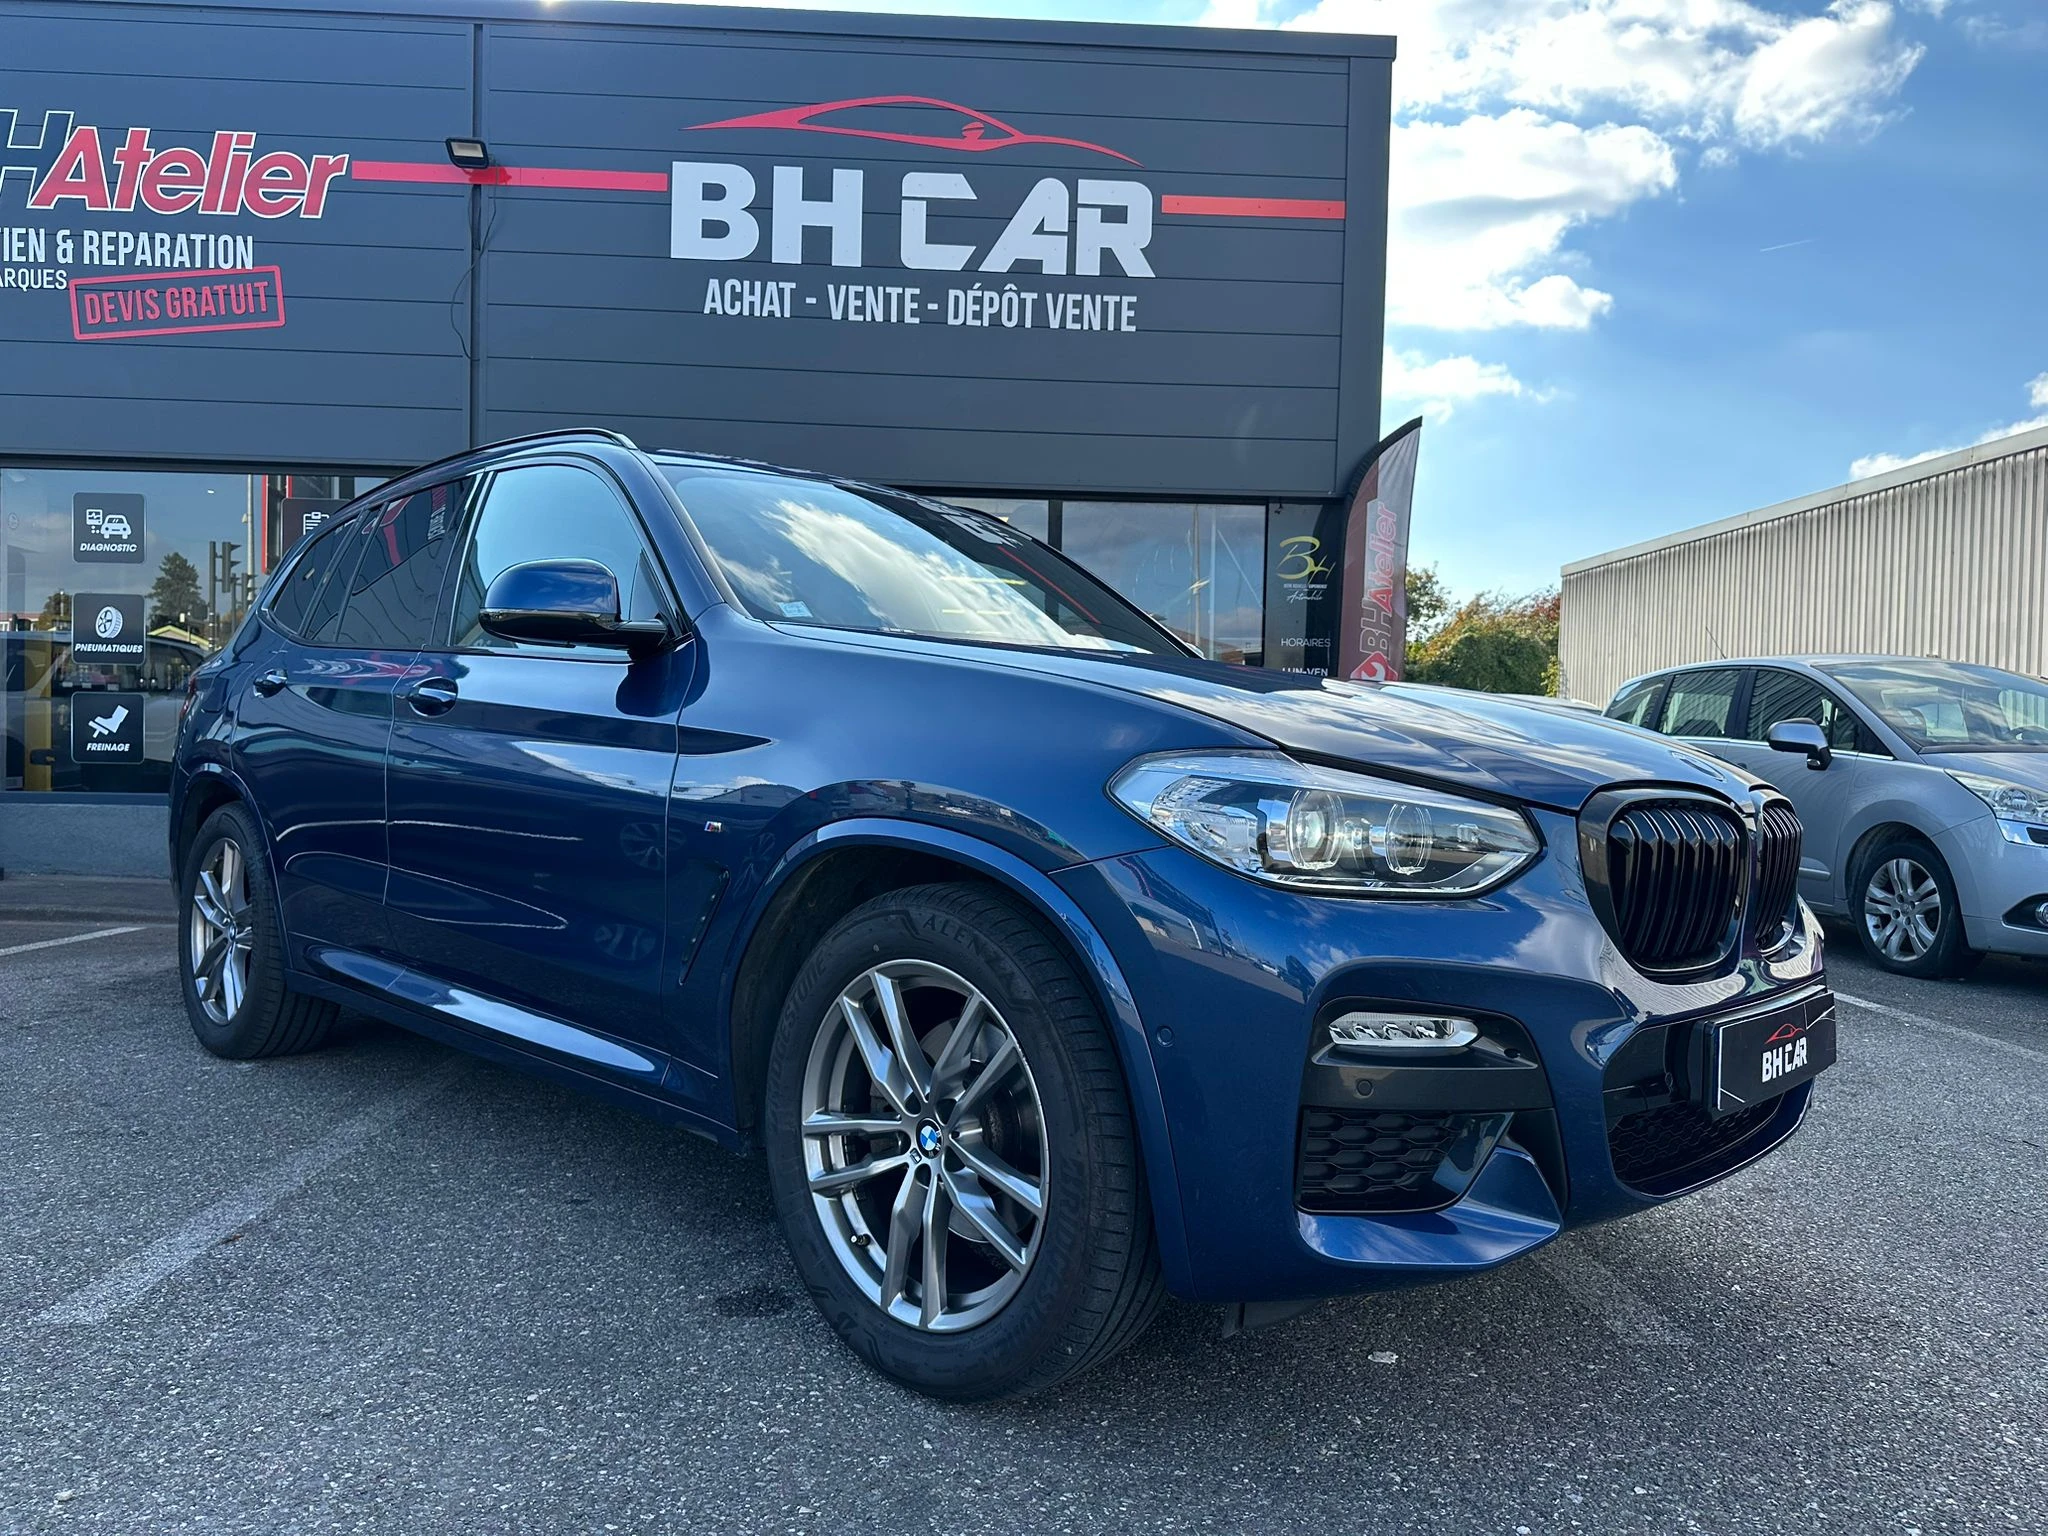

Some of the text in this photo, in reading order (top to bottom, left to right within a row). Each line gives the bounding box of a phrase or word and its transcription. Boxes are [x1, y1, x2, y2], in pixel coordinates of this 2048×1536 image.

[671, 161, 1156, 278] BH CAR
[0, 227, 254, 271] IEN & REPARATION
[84, 281, 269, 325] DEVIS GRATUIT
[703, 278, 796, 318] ACHAT
[827, 283, 920, 324] VENTE
[947, 283, 1038, 329] DÉPÔT
[1045, 292, 1137, 332] VENTE
[80, 542, 137, 553] DIAGNOSTIC
[1360, 502, 1398, 660] BHAtelier
[75, 643, 143, 653] PNEUMATIQUES
[1281, 638, 1331, 647] HORAIRES
[86, 742, 130, 752] FREINAGE
[1761, 1036, 1808, 1083] BH CAR
